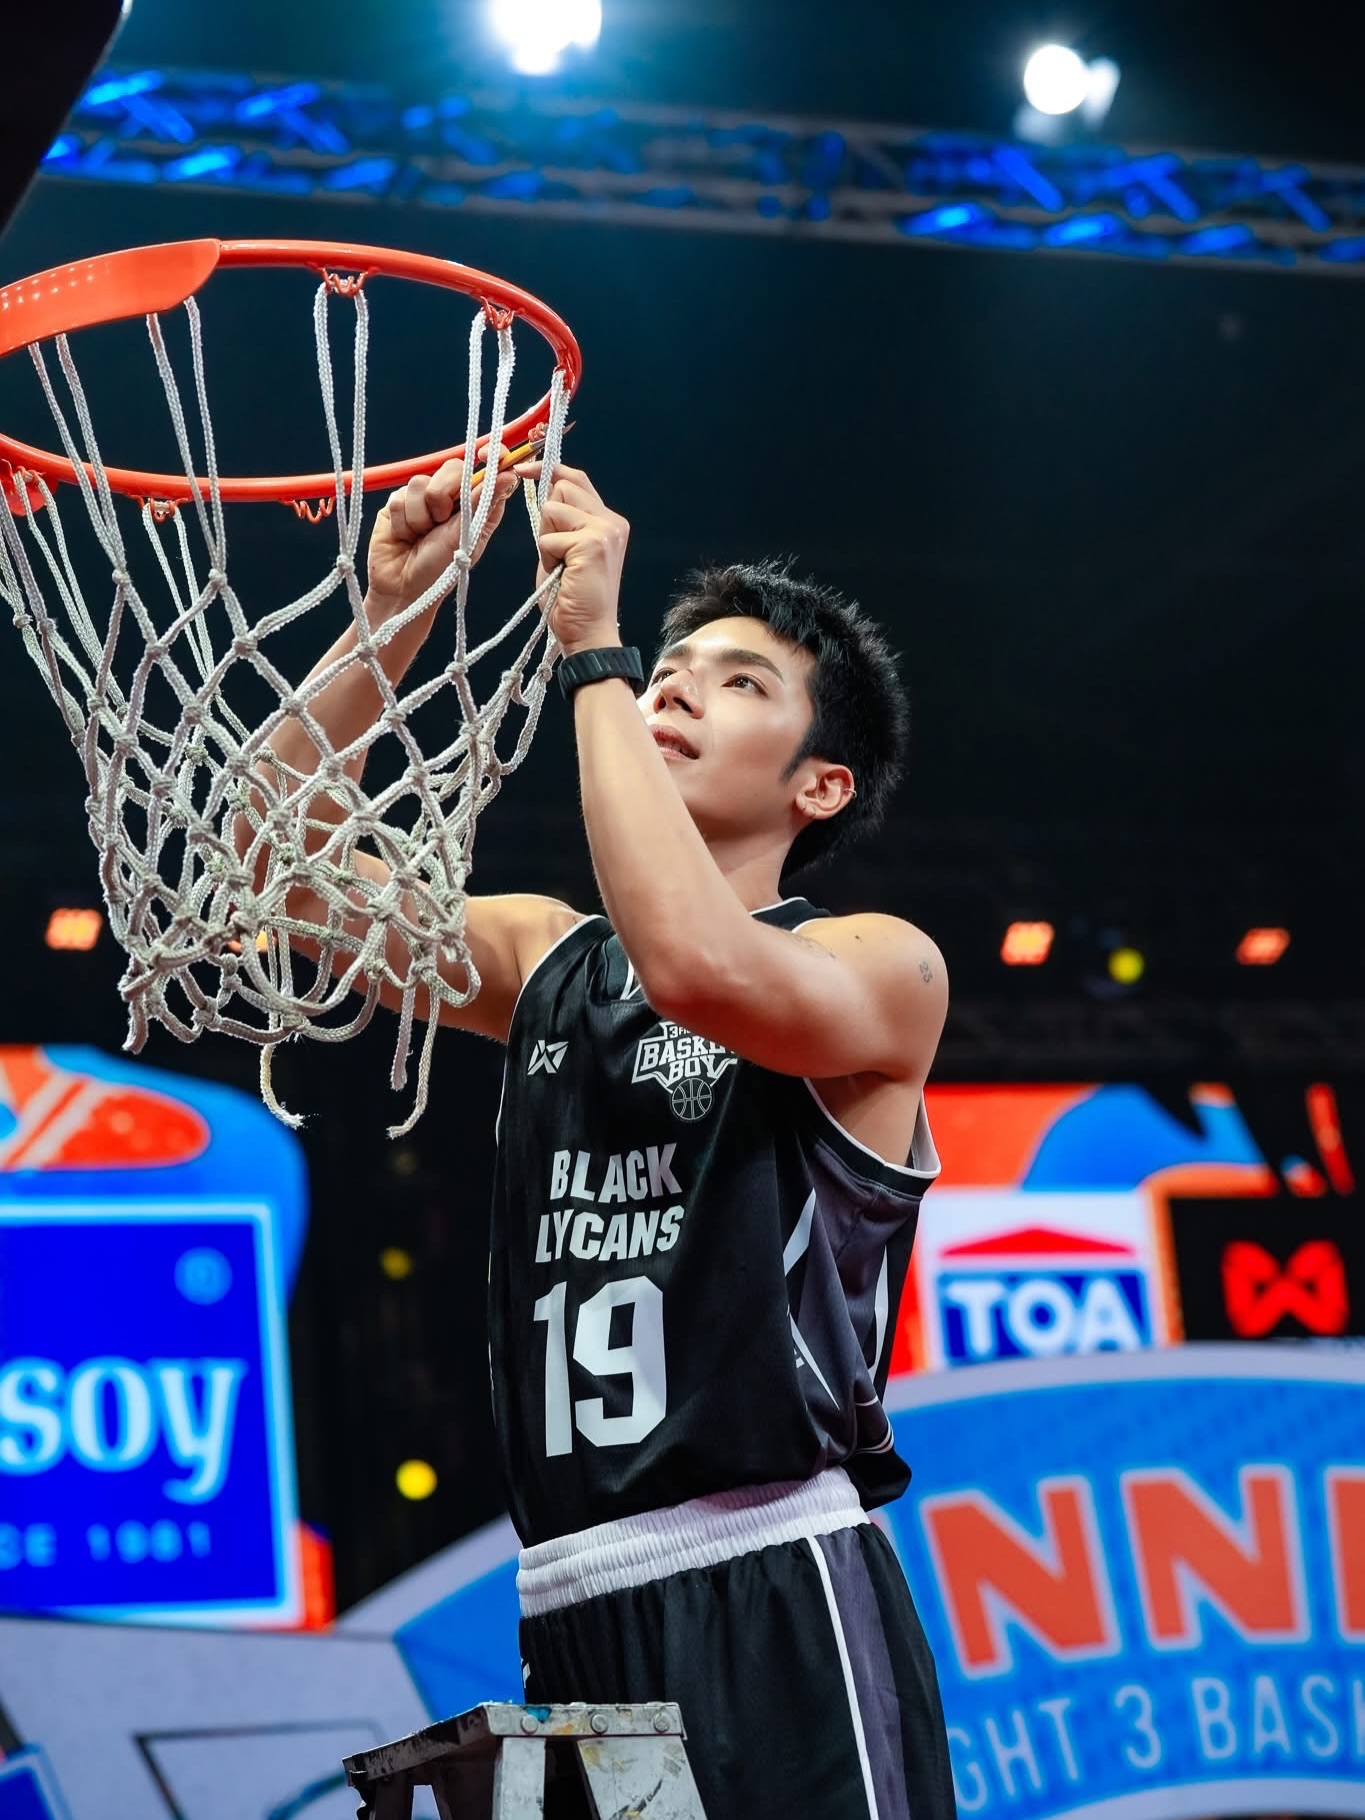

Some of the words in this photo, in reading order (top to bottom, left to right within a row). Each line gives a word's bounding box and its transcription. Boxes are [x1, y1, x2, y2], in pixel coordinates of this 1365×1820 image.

[667, 1054, 717, 1087] BOY
[550, 1143, 682, 1203] BLACK
[535, 1205, 685, 1264] LYCANS
[946, 1279, 1142, 1356] TOA
[533, 1275, 667, 1458] 19
[1115, 1684, 1162, 1768] 3
